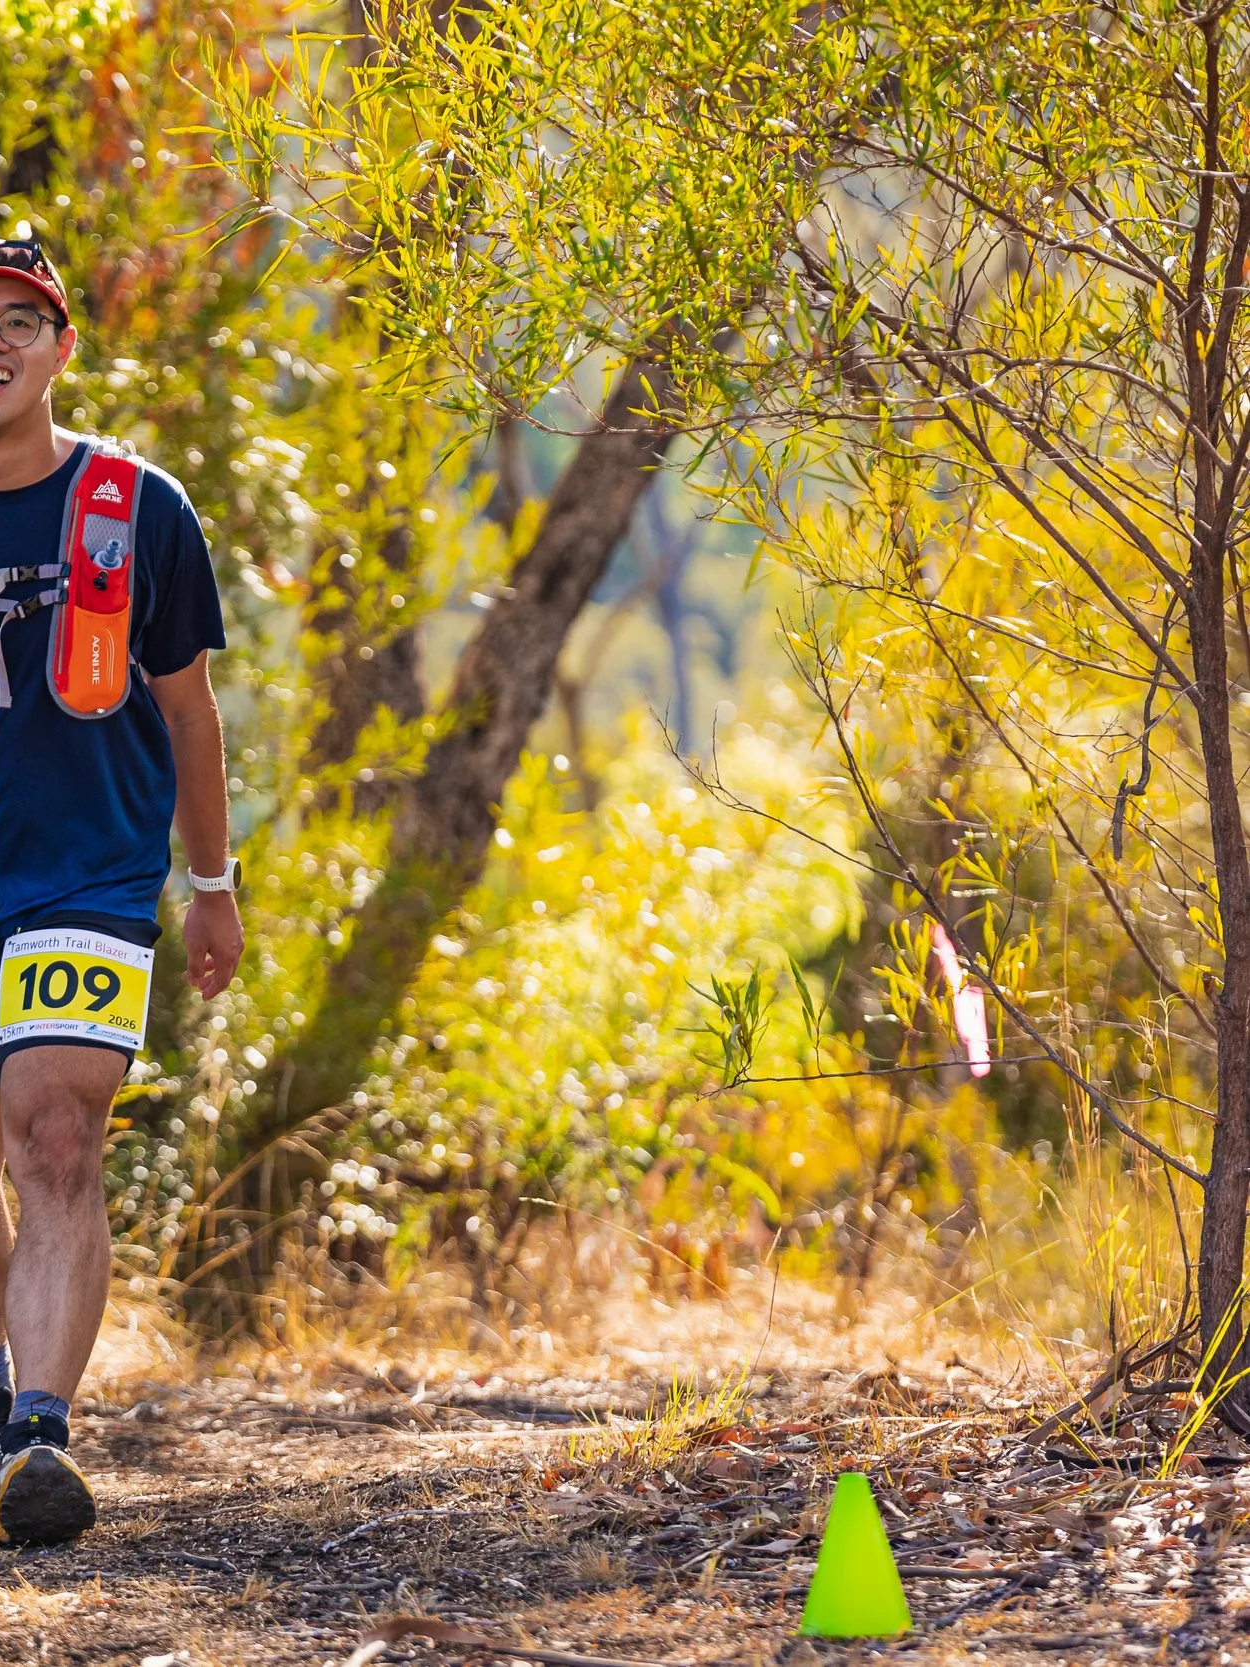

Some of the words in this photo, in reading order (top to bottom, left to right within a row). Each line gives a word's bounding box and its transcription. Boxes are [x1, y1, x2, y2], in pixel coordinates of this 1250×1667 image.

[91, 634, 101, 685] AONIJIE
[10, 936, 60, 953] Tamworth
[65, 936, 91, 950] Trail
[95, 941, 129, 960] Blazer
[18, 960, 121, 1012] 109
[2, 1025, 25, 1039] 15km
[34, 1022, 80, 1031] INTERSPORT
[108, 1014, 136, 1030] 2026
